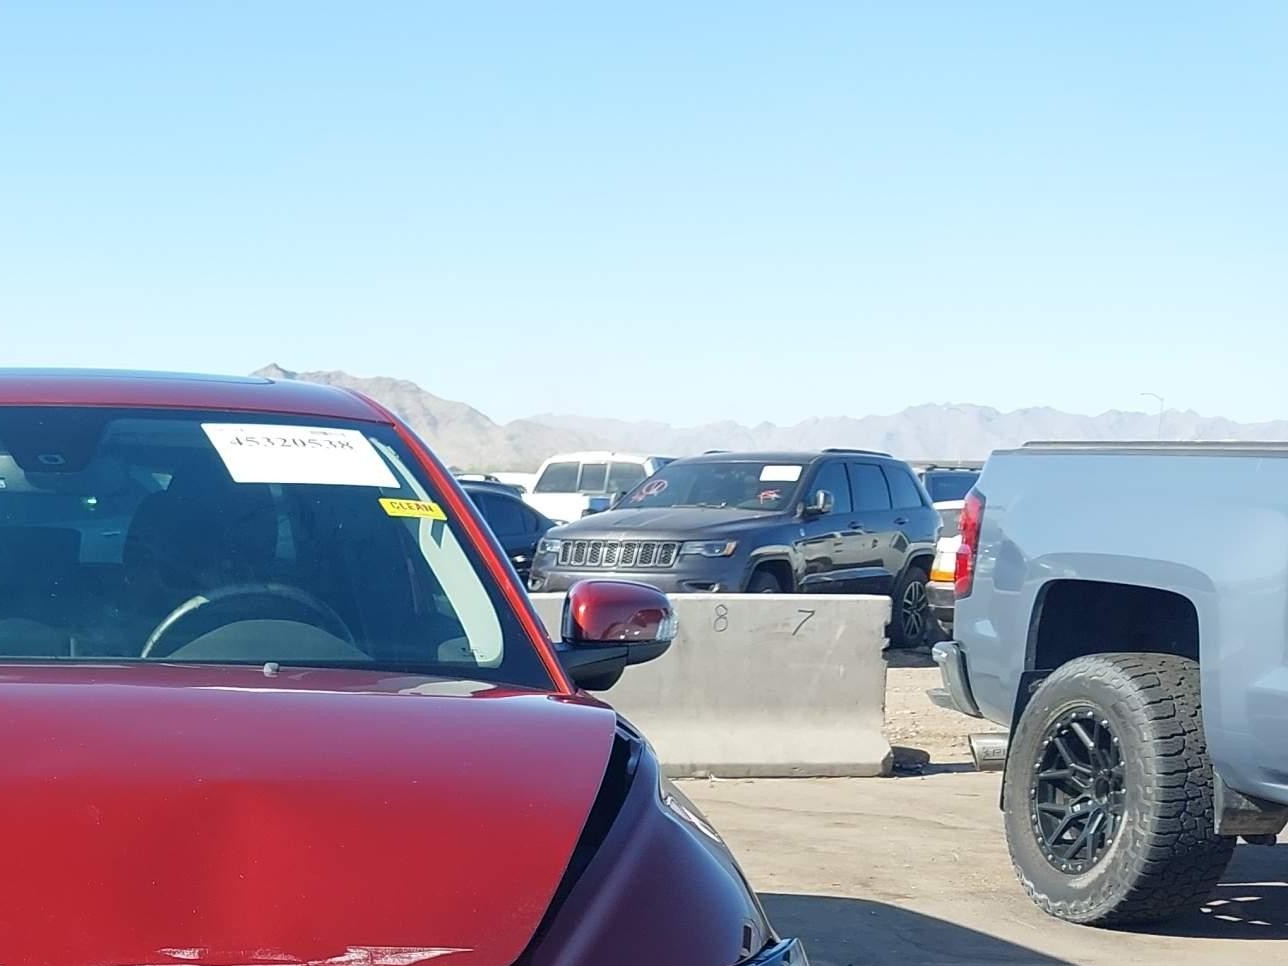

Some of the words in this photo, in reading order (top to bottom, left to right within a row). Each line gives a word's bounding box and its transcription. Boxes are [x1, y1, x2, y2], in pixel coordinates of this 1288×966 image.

[229, 435, 355, 451] 45320538
[389, 501, 435, 513] CLEAN
[714, 604, 729, 633] 8
[792, 609, 816, 636] 7
